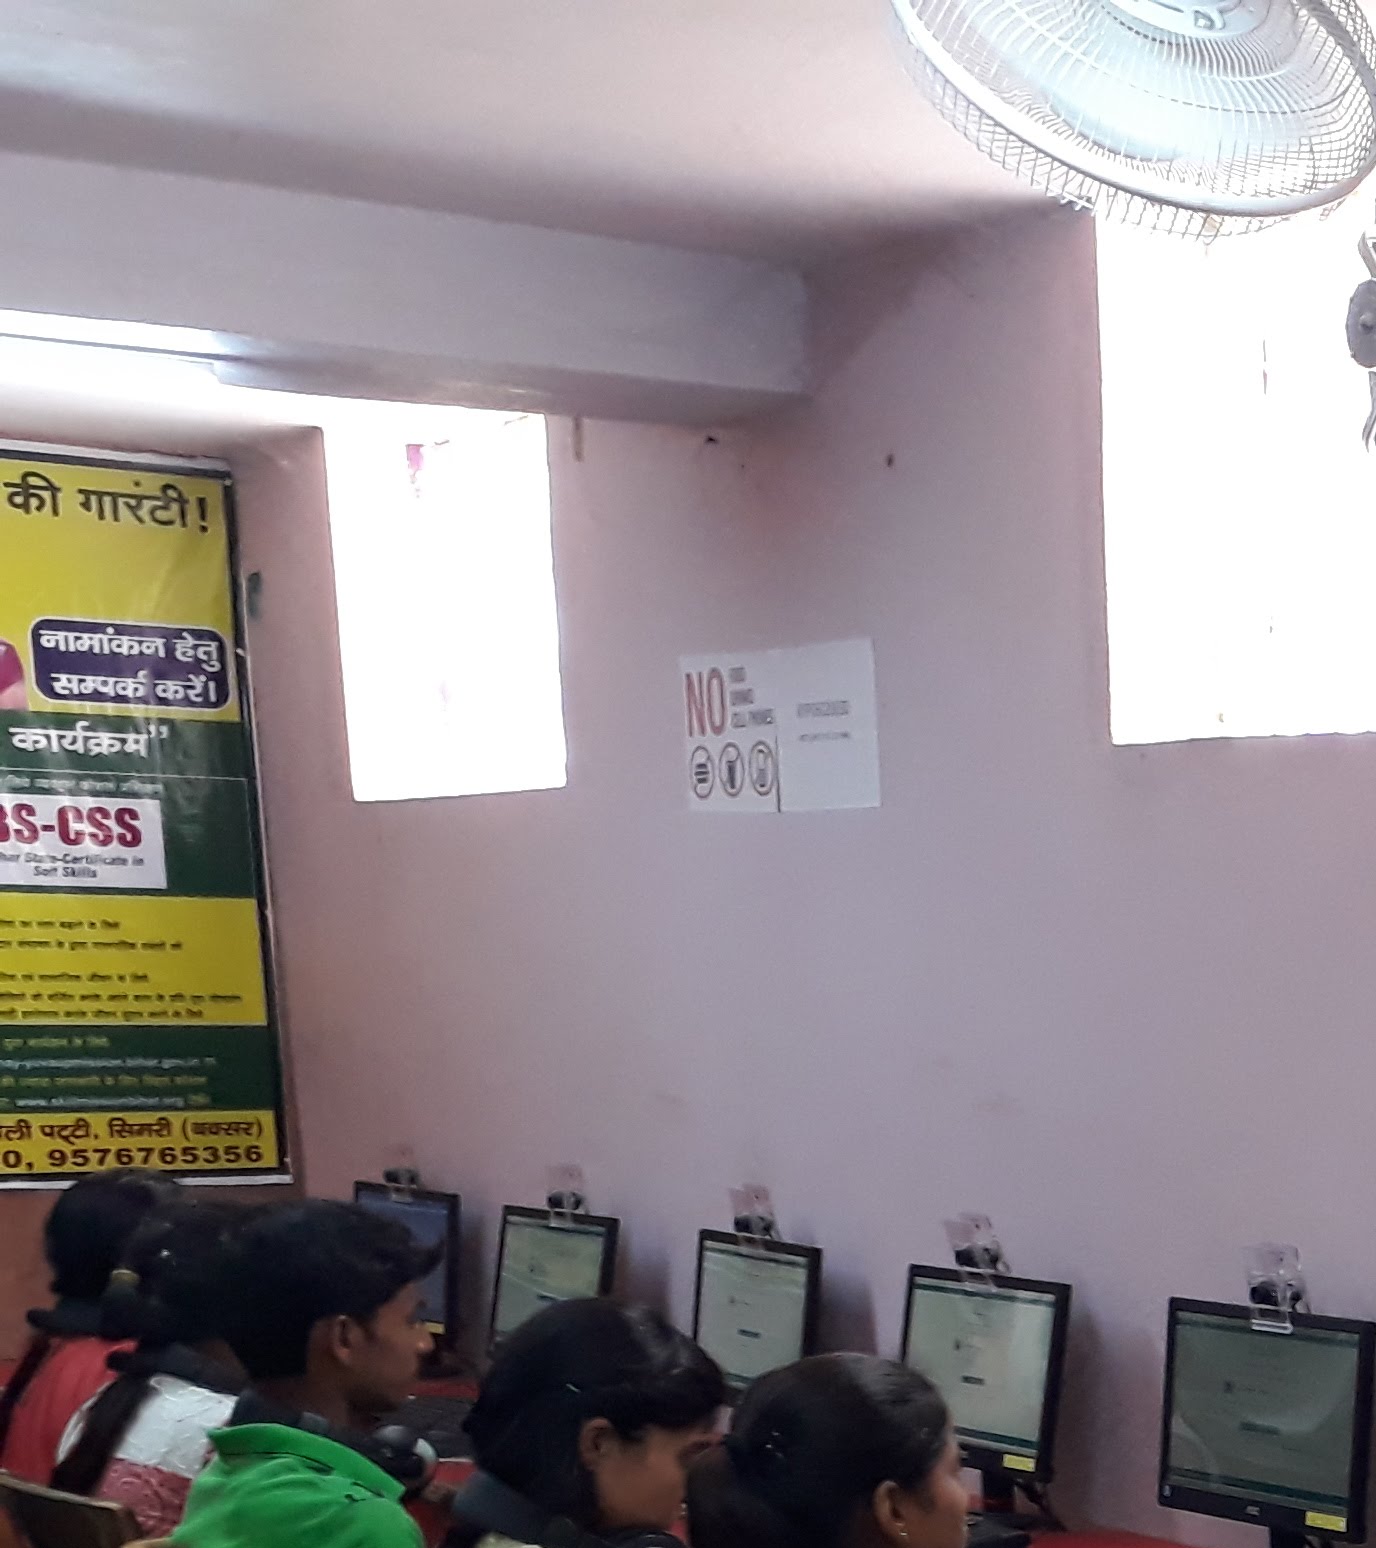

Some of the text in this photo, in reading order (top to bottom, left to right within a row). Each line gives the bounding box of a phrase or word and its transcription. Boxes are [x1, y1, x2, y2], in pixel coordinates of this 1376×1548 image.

[3, 471, 61, 517] की
[39, 626, 222, 673] नामांकन हेतु
[50, 670, 147, 699] सम्पर्क
[685, 667, 726, 738] NO
[49, 1145, 264, 1168] 9576765356
